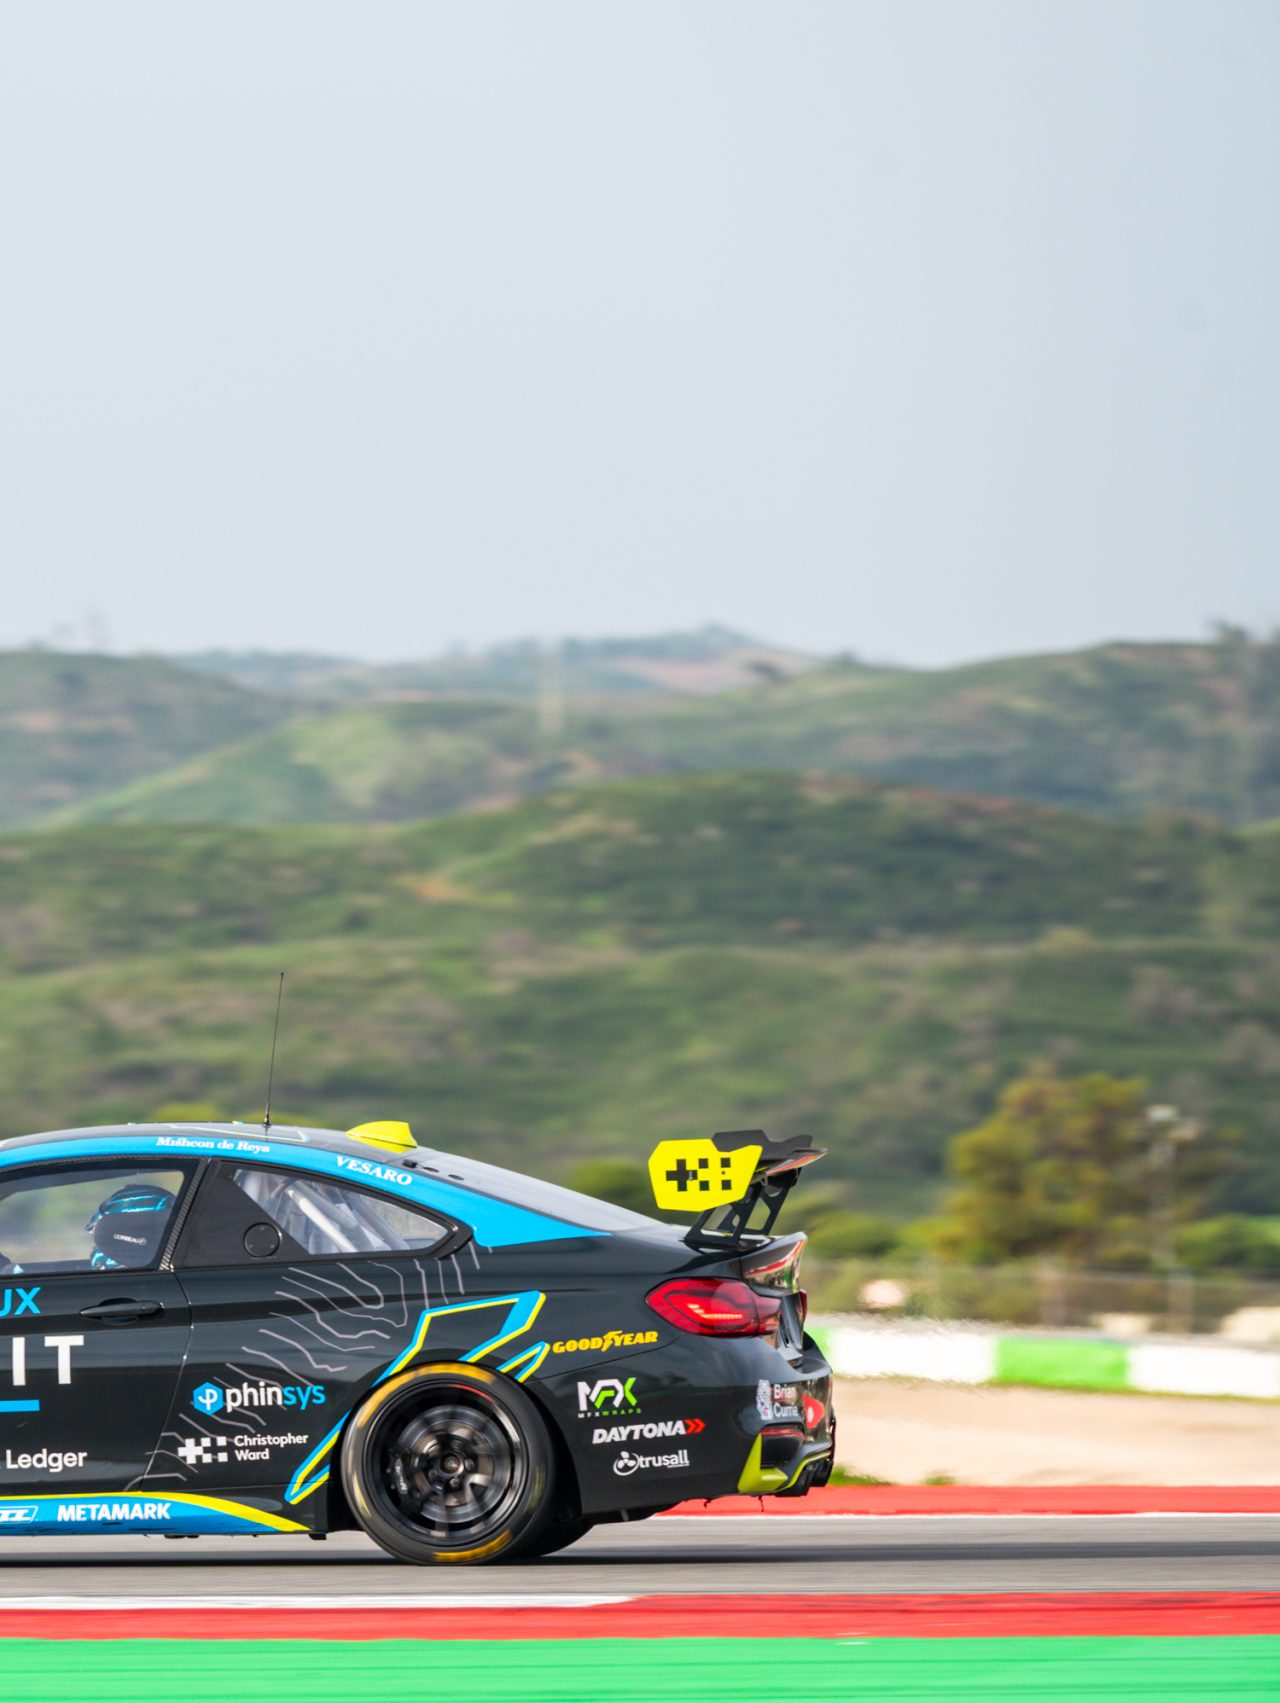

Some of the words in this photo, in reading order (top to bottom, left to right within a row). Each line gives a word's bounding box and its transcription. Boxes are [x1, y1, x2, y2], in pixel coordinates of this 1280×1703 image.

[156, 1136, 215, 1148] Mishcon
[217, 1140, 234, 1149] de
[236, 1141, 270, 1154] Reya
[336, 1155, 413, 1186] VESARO
[552, 1330, 658, 1353] GOODYEAR
[225, 1381, 326, 1413] phinsys
[773, 1384, 797, 1399] Brian
[234, 1432, 309, 1448] Christopher
[592, 1420, 686, 1444] DAYTONA
[6, 1449, 87, 1472] Ledger
[235, 1449, 270, 1461] Ward
[639, 1449, 690, 1468] trusall
[57, 1503, 172, 1522] METAMARK
